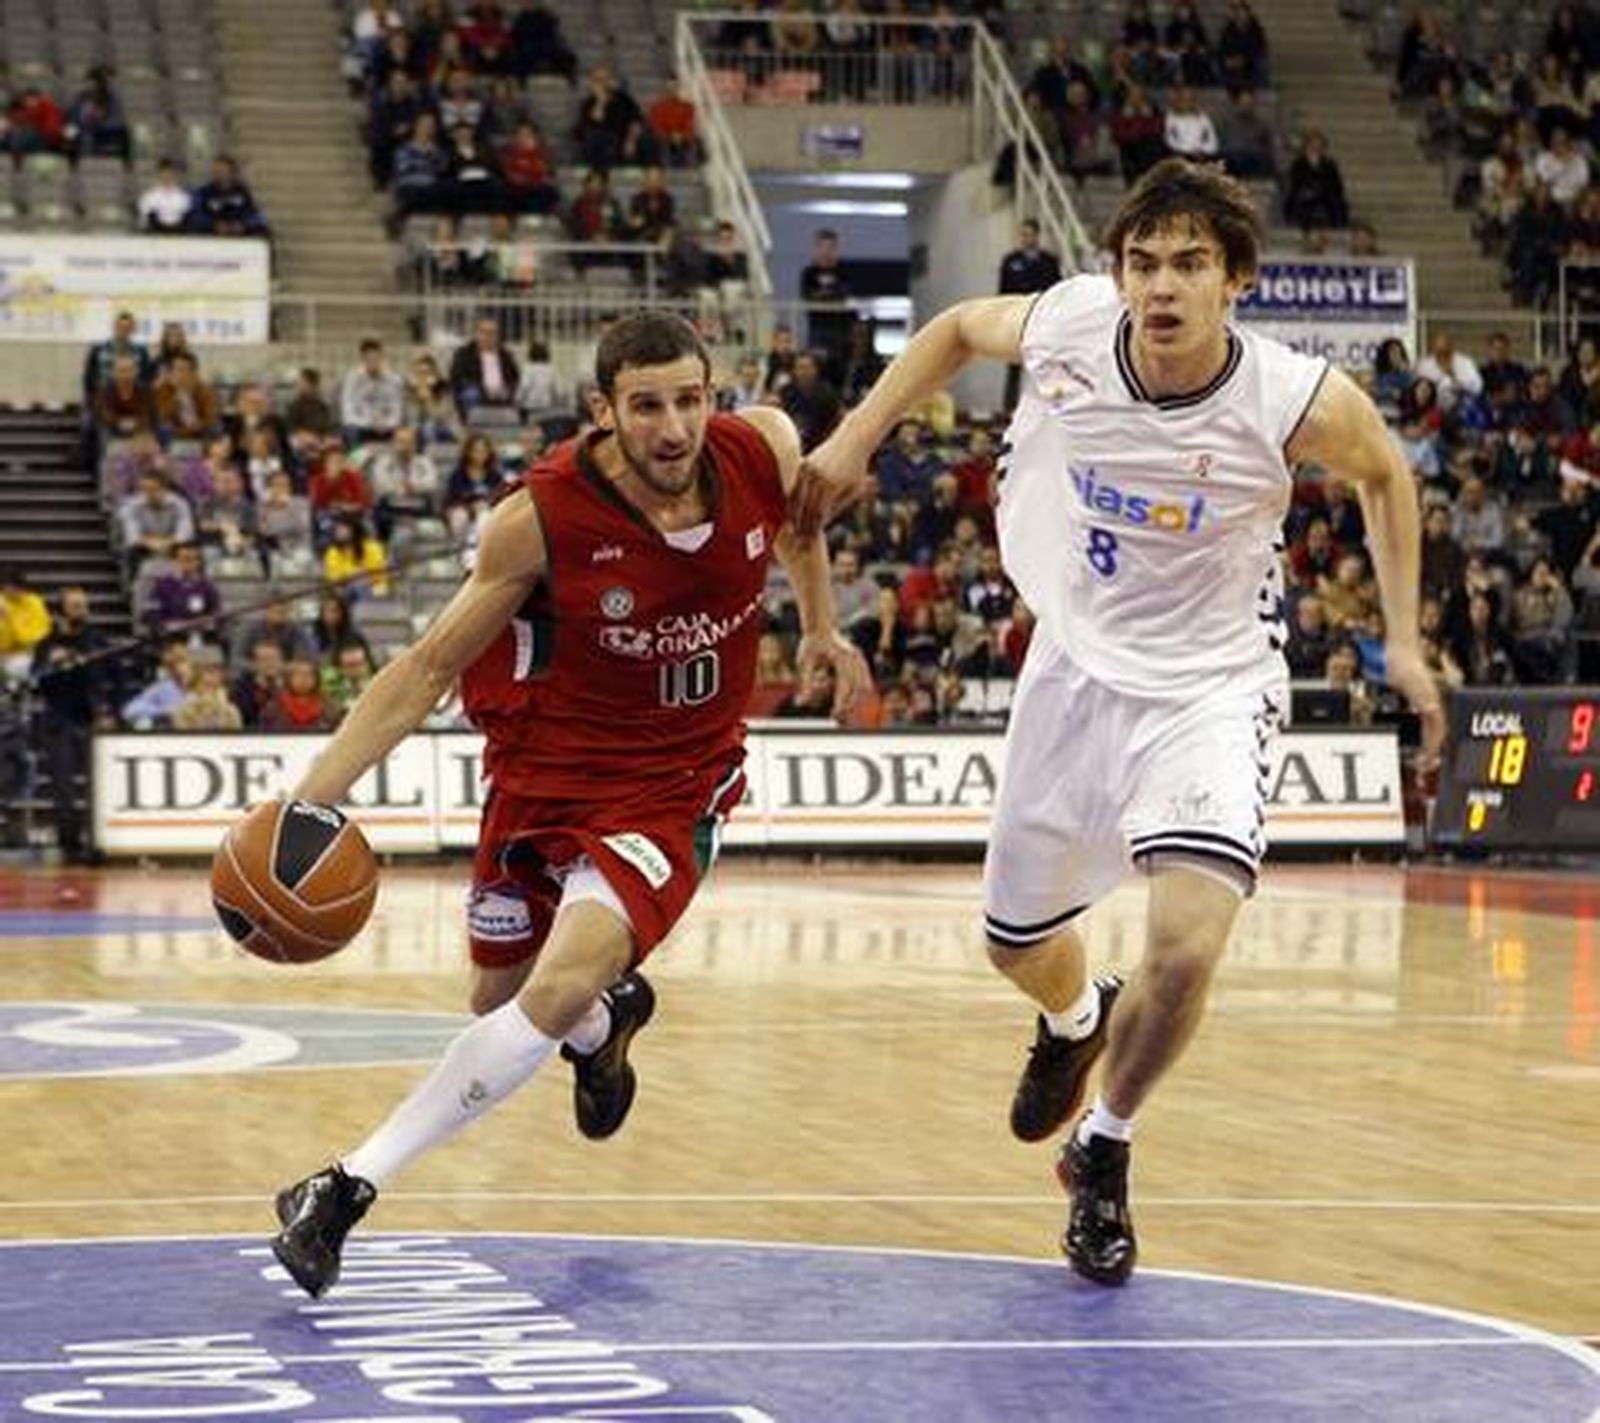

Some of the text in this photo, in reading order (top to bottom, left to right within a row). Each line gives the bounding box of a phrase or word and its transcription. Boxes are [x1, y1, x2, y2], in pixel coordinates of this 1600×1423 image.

[1086, 525, 1119, 577] 8
[659, 650, 720, 708] 10
[1471, 711, 1522, 736] LOCAL
[1568, 703, 1595, 753] 9
[113, 753, 424, 812] IDEL
[774, 752, 997, 807] IDEA
[1489, 737, 1527, 785] 18
